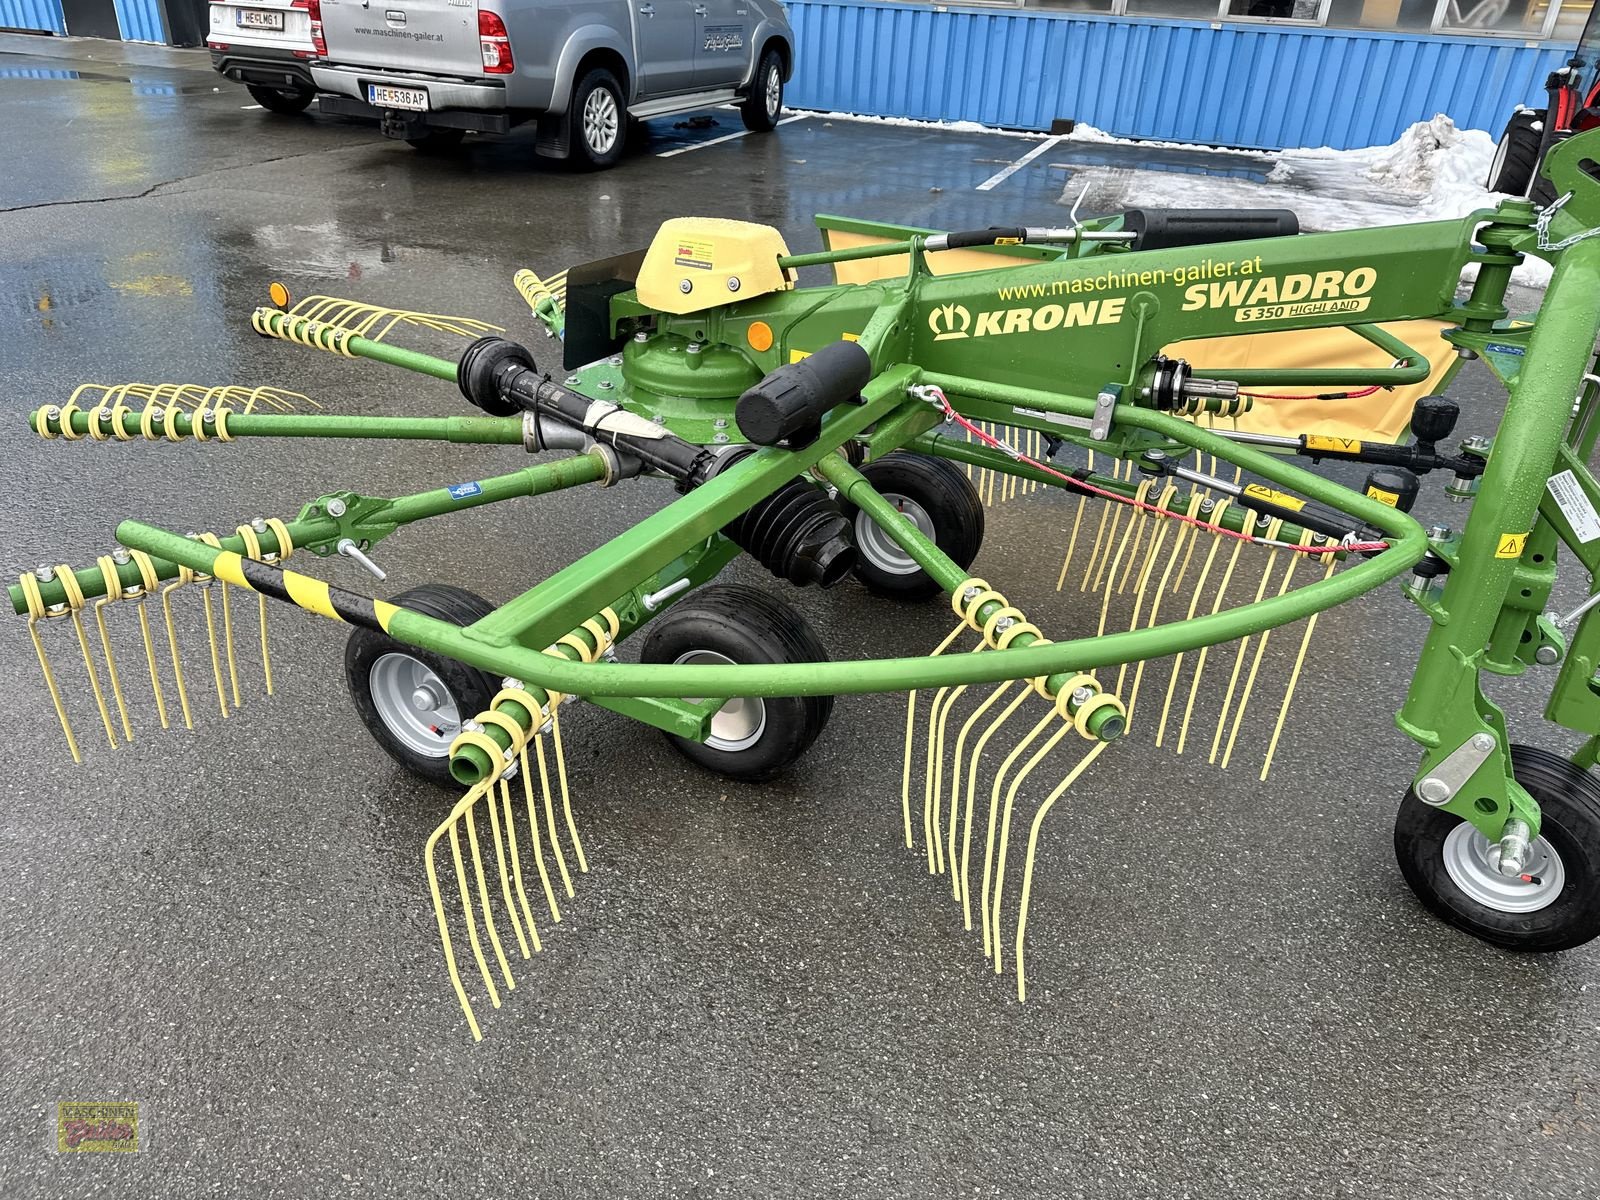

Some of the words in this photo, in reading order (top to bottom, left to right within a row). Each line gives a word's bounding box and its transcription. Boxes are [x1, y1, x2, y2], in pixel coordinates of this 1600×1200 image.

[354, 26, 444, 42] www.maschinen-gailer.at
[376, 88, 388, 102] HE
[393, 90, 411, 104] 536
[412, 92, 425, 106] AP
[997, 255, 1263, 301] www.maschinen-gailer.at
[1181, 266, 1378, 312] SWADRO
[973, 297, 1127, 338] KRONE
[1241, 309, 1252, 321] S
[1255, 306, 1285, 320] 350
[1288, 299, 1360, 317] HIGHLAND
